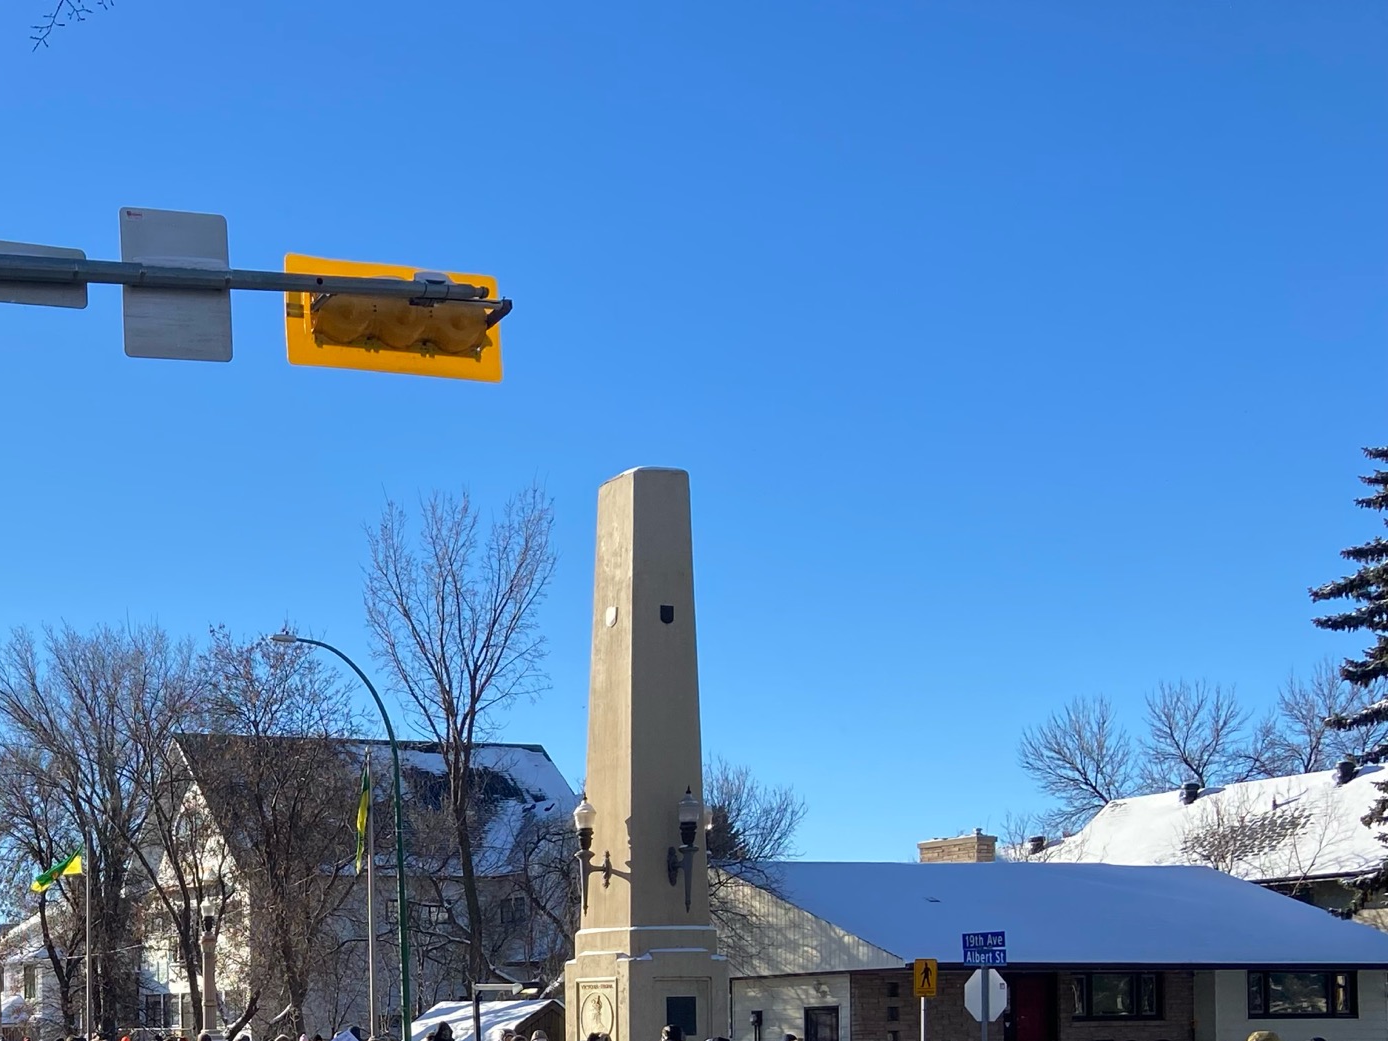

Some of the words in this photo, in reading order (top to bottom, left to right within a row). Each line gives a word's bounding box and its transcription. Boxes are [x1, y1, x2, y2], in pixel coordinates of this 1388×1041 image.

[965, 934, 984, 947] 19th
[986, 933, 1003, 946] Ave
[966, 951, 992, 963] Albert
[995, 951, 1004, 963] St
